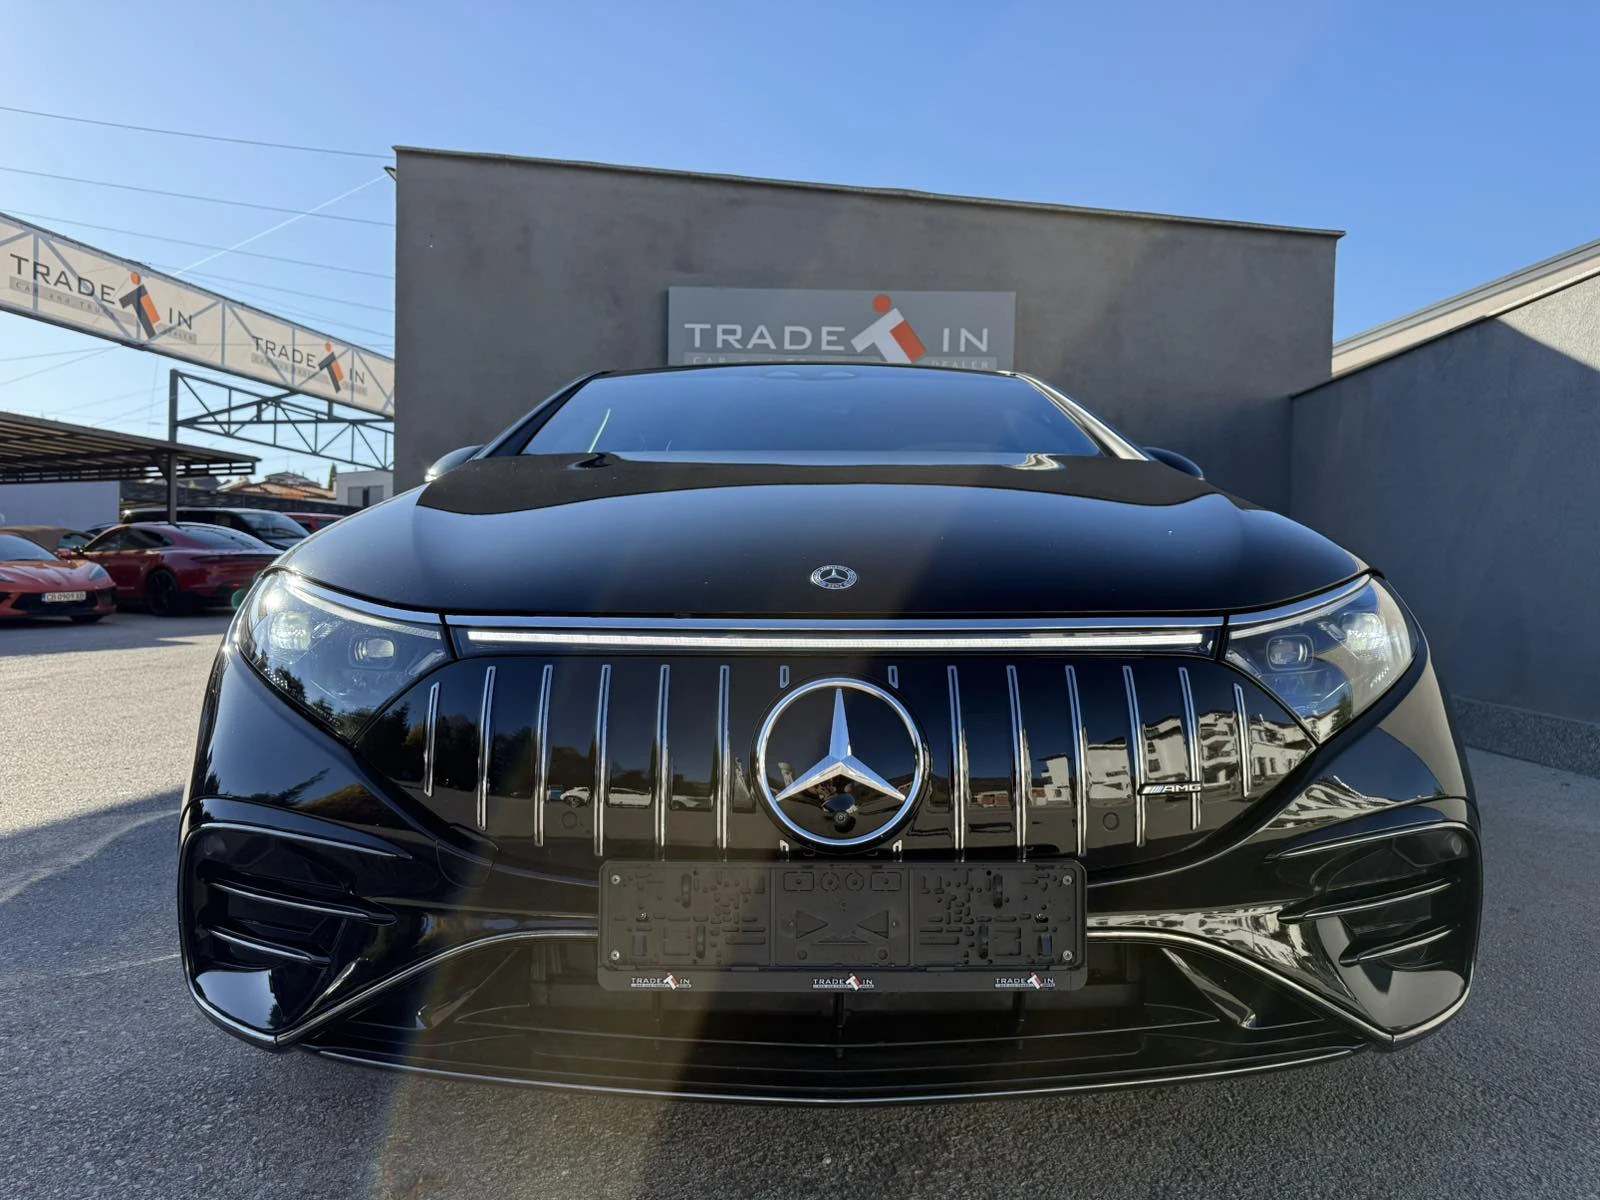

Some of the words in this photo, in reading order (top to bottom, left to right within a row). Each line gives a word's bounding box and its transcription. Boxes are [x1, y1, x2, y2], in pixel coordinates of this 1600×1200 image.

[10, 253, 116, 305] TRADE
[169, 307, 193, 330] IN
[684, 323, 846, 351] TRADE
[942, 327, 989, 353] IN
[252, 336, 317, 369] TRADE
[349, 367, 365, 384] IN
[1162, 783, 1202, 793] AMG
